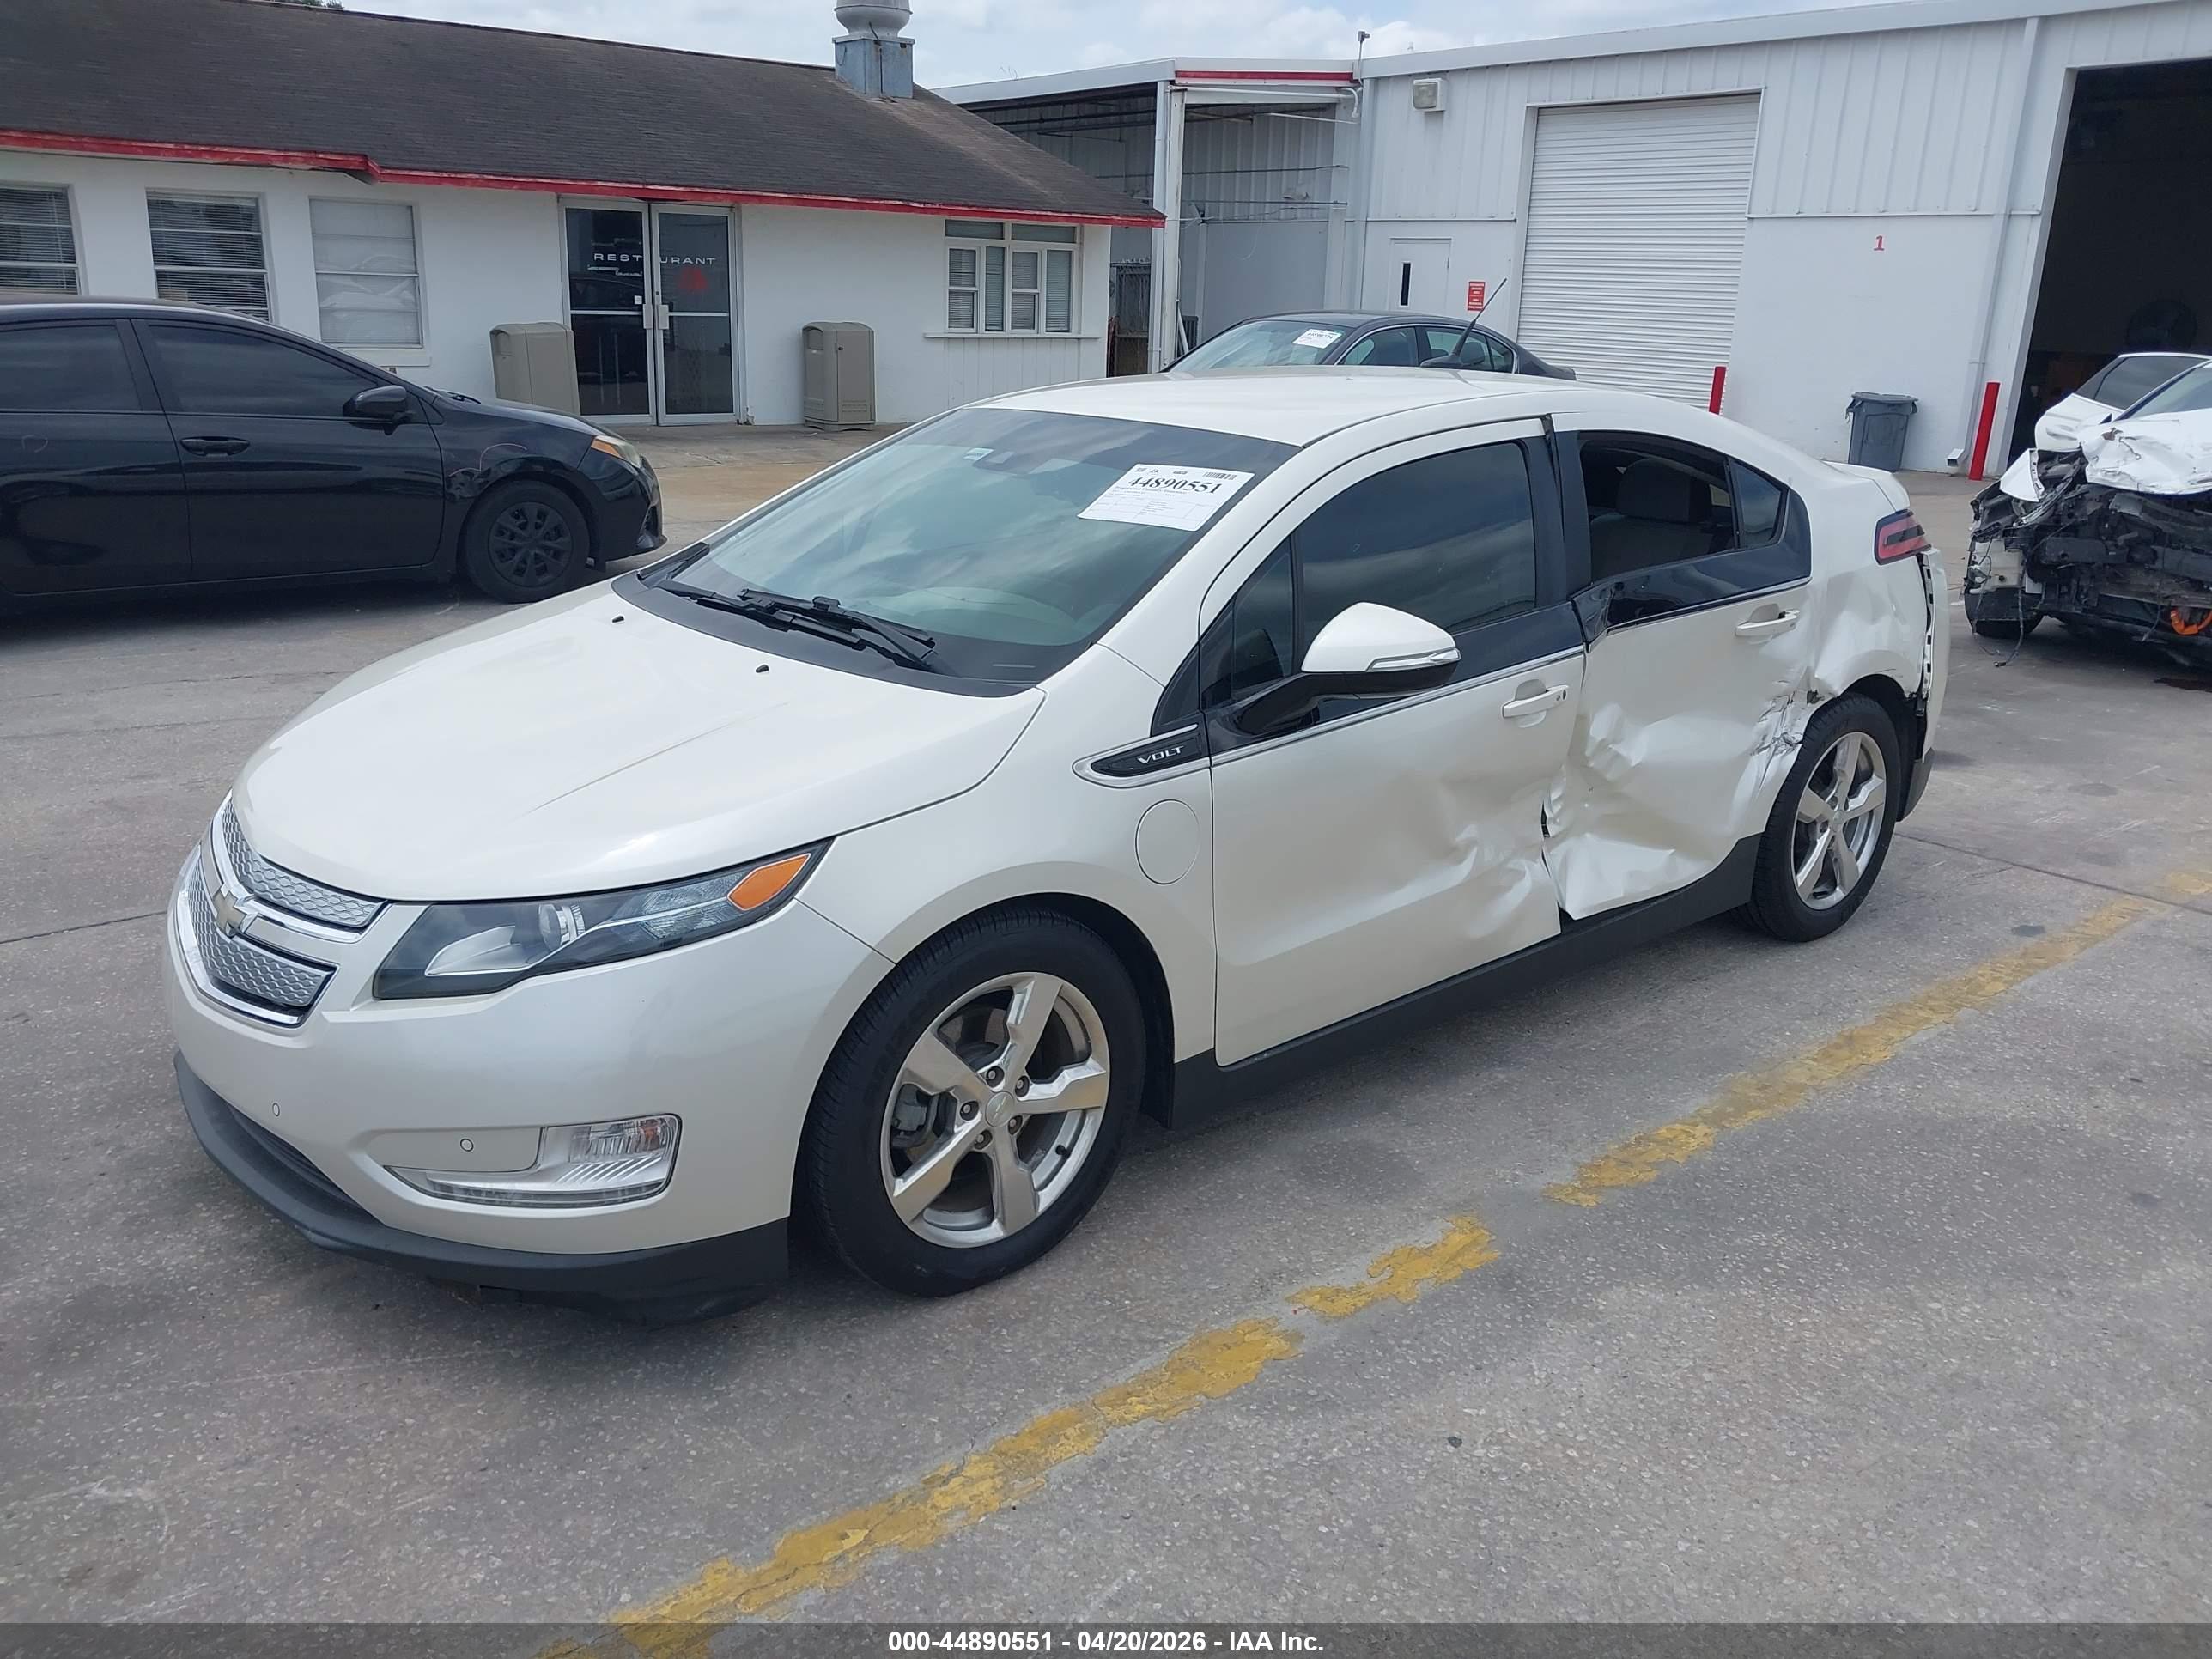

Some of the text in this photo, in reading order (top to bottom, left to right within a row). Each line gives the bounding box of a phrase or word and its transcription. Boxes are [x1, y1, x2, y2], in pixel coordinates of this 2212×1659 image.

[1873, 234, 1885, 252] 1
[1127, 476, 1223, 495] 44890551
[1137, 745, 1184, 764] VOLT
